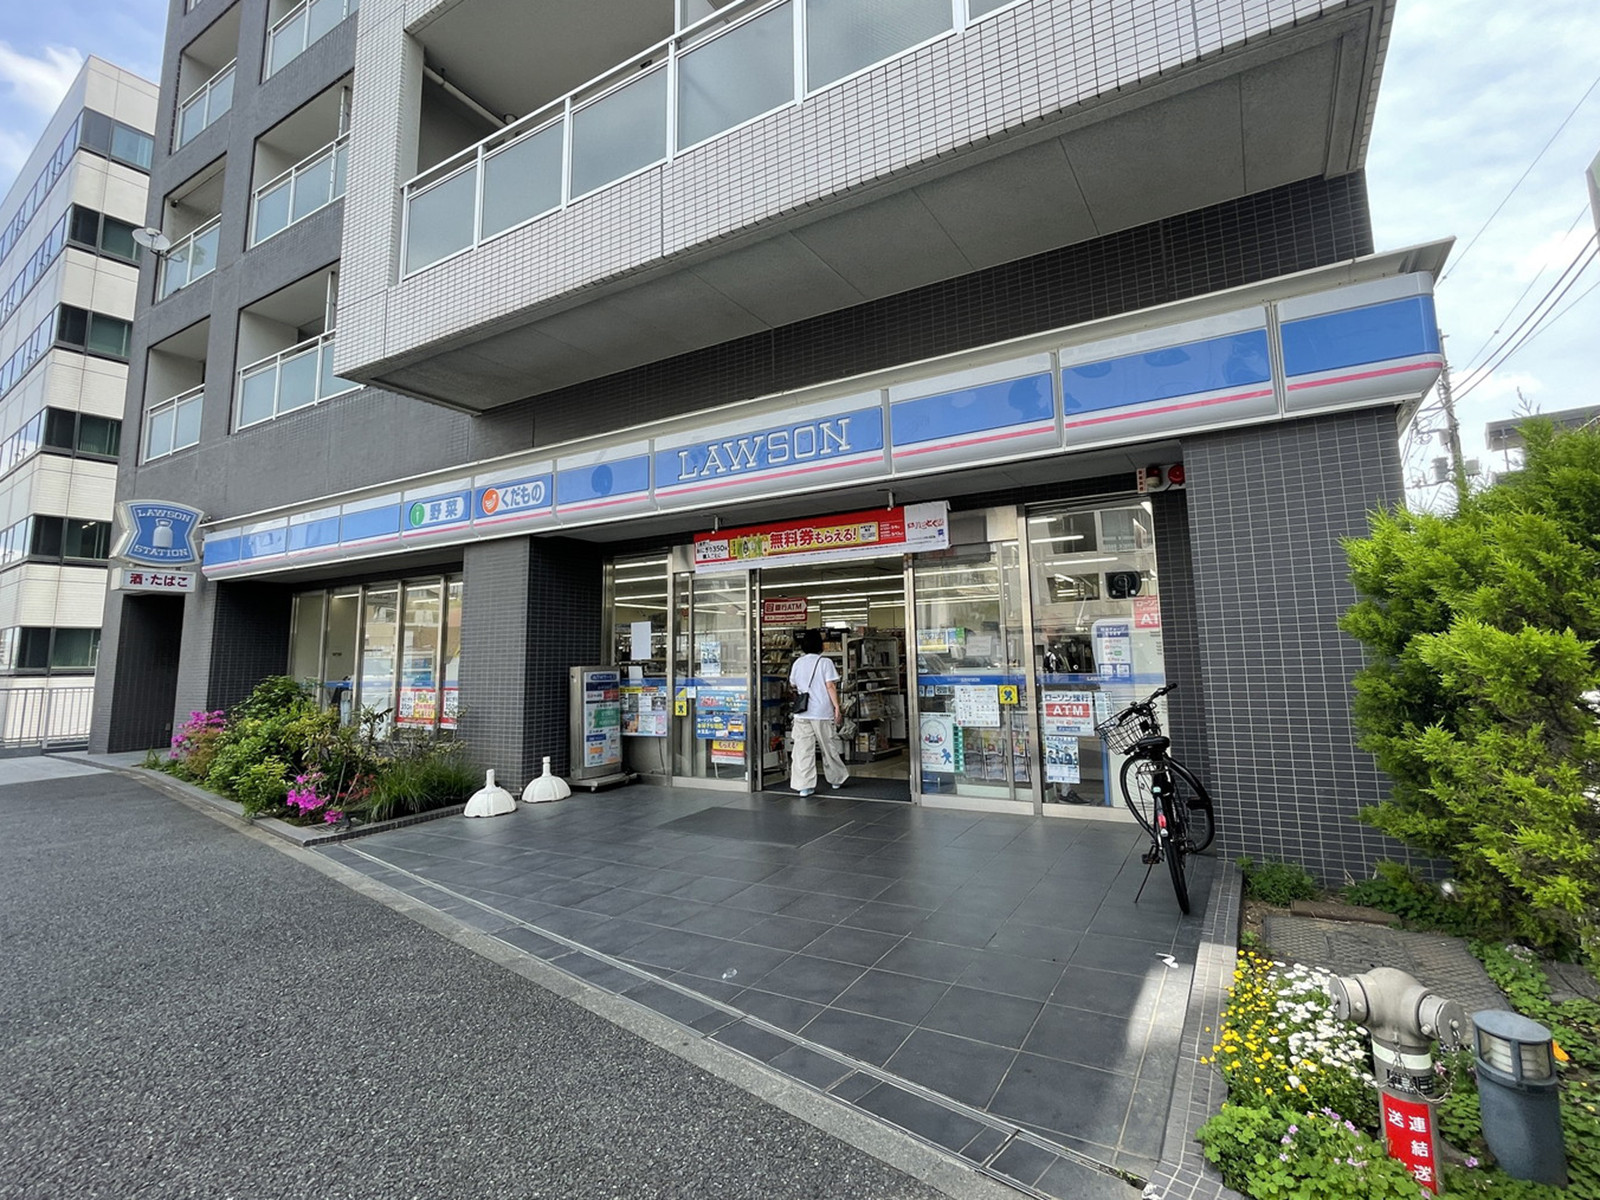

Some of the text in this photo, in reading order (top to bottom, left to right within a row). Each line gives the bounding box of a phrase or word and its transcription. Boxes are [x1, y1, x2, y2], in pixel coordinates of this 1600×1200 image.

[678, 418, 851, 480] LAWSON
[501, 484, 541, 507] くだもの
[137, 509, 191, 522] LAWSON
[133, 545, 188, 556] STATION
[129, 573, 188, 587] 酒・たばこ
[1052, 705, 1083, 716] ATM
